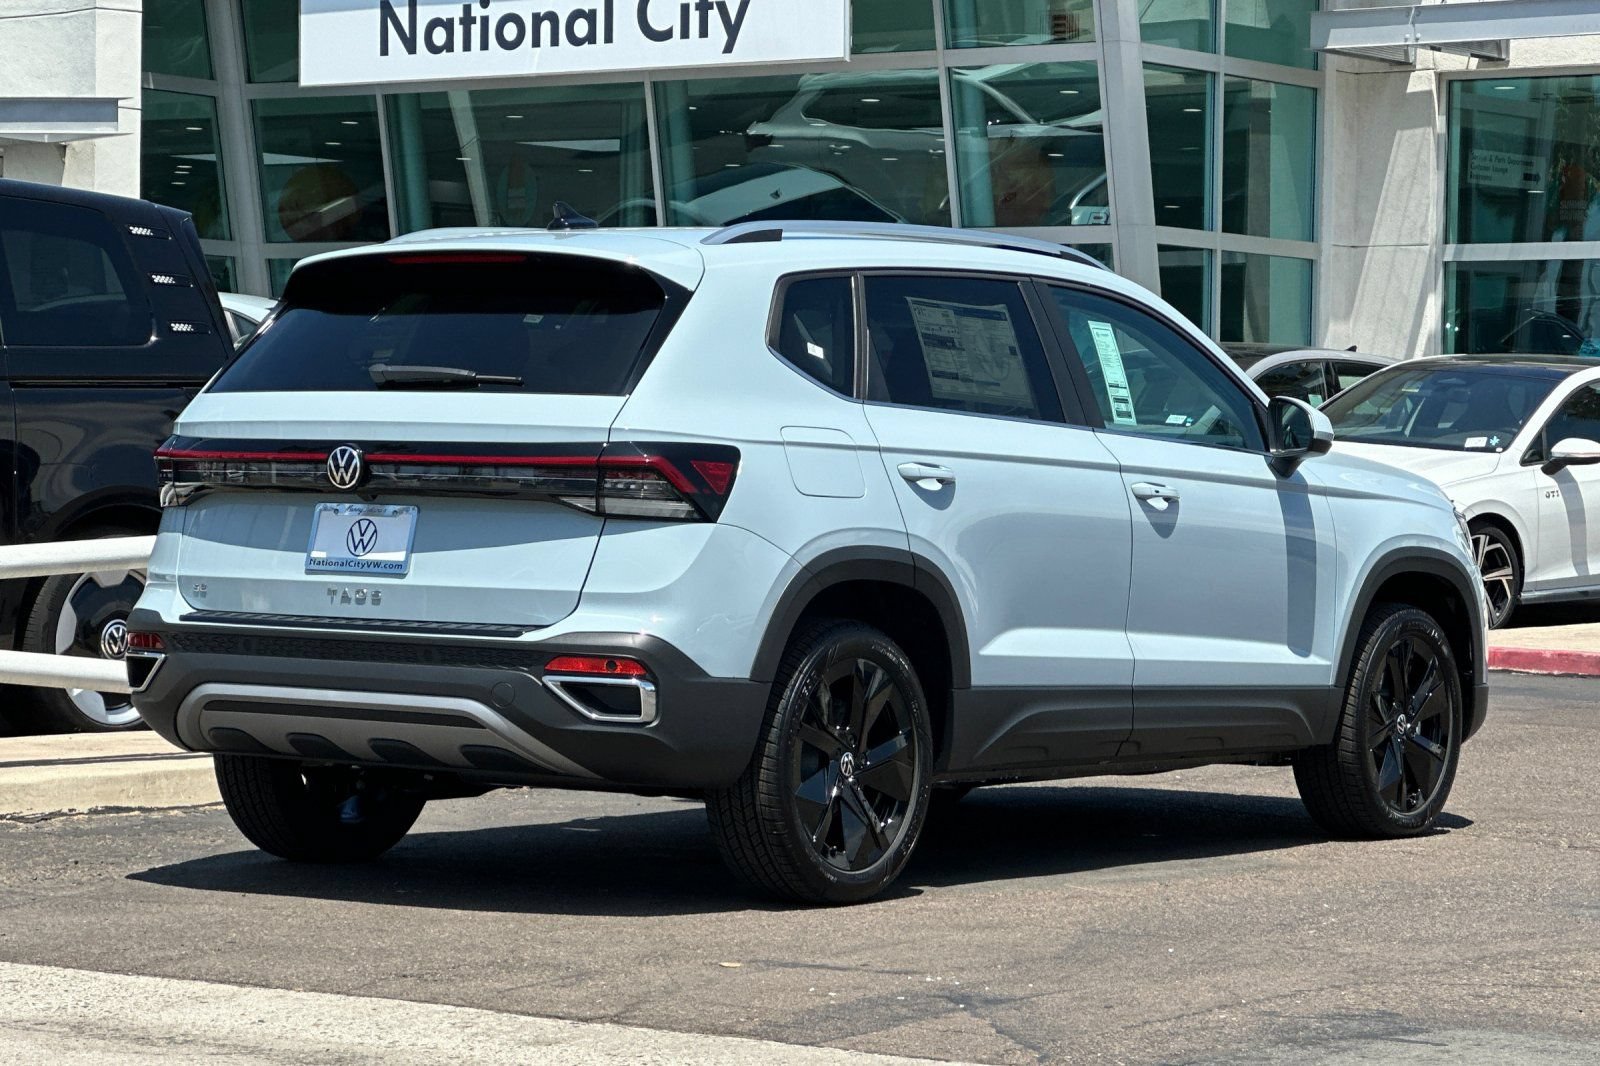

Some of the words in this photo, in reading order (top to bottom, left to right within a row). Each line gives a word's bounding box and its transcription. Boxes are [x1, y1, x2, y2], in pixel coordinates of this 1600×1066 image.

[379, 0, 614, 56] National
[637, 0, 751, 54] City
[309, 558, 402, 570] NationalCityVW.com
